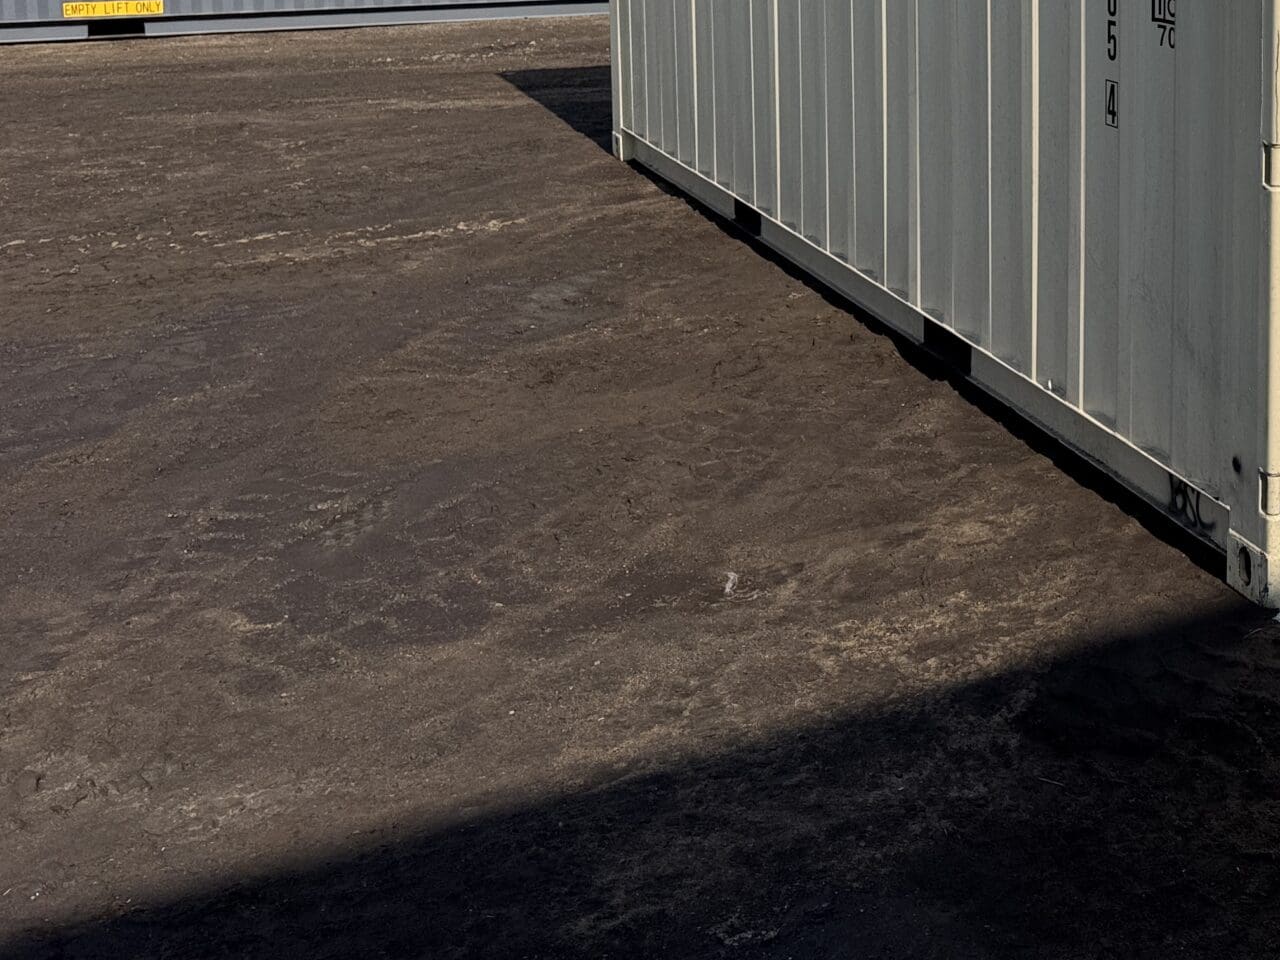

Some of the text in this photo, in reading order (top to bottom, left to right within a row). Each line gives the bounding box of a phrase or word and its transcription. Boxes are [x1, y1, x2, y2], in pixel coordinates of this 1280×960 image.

[64, 1, 161, 16] EMPTY LIFT ONLY
[1106, 82, 1117, 126] 4
